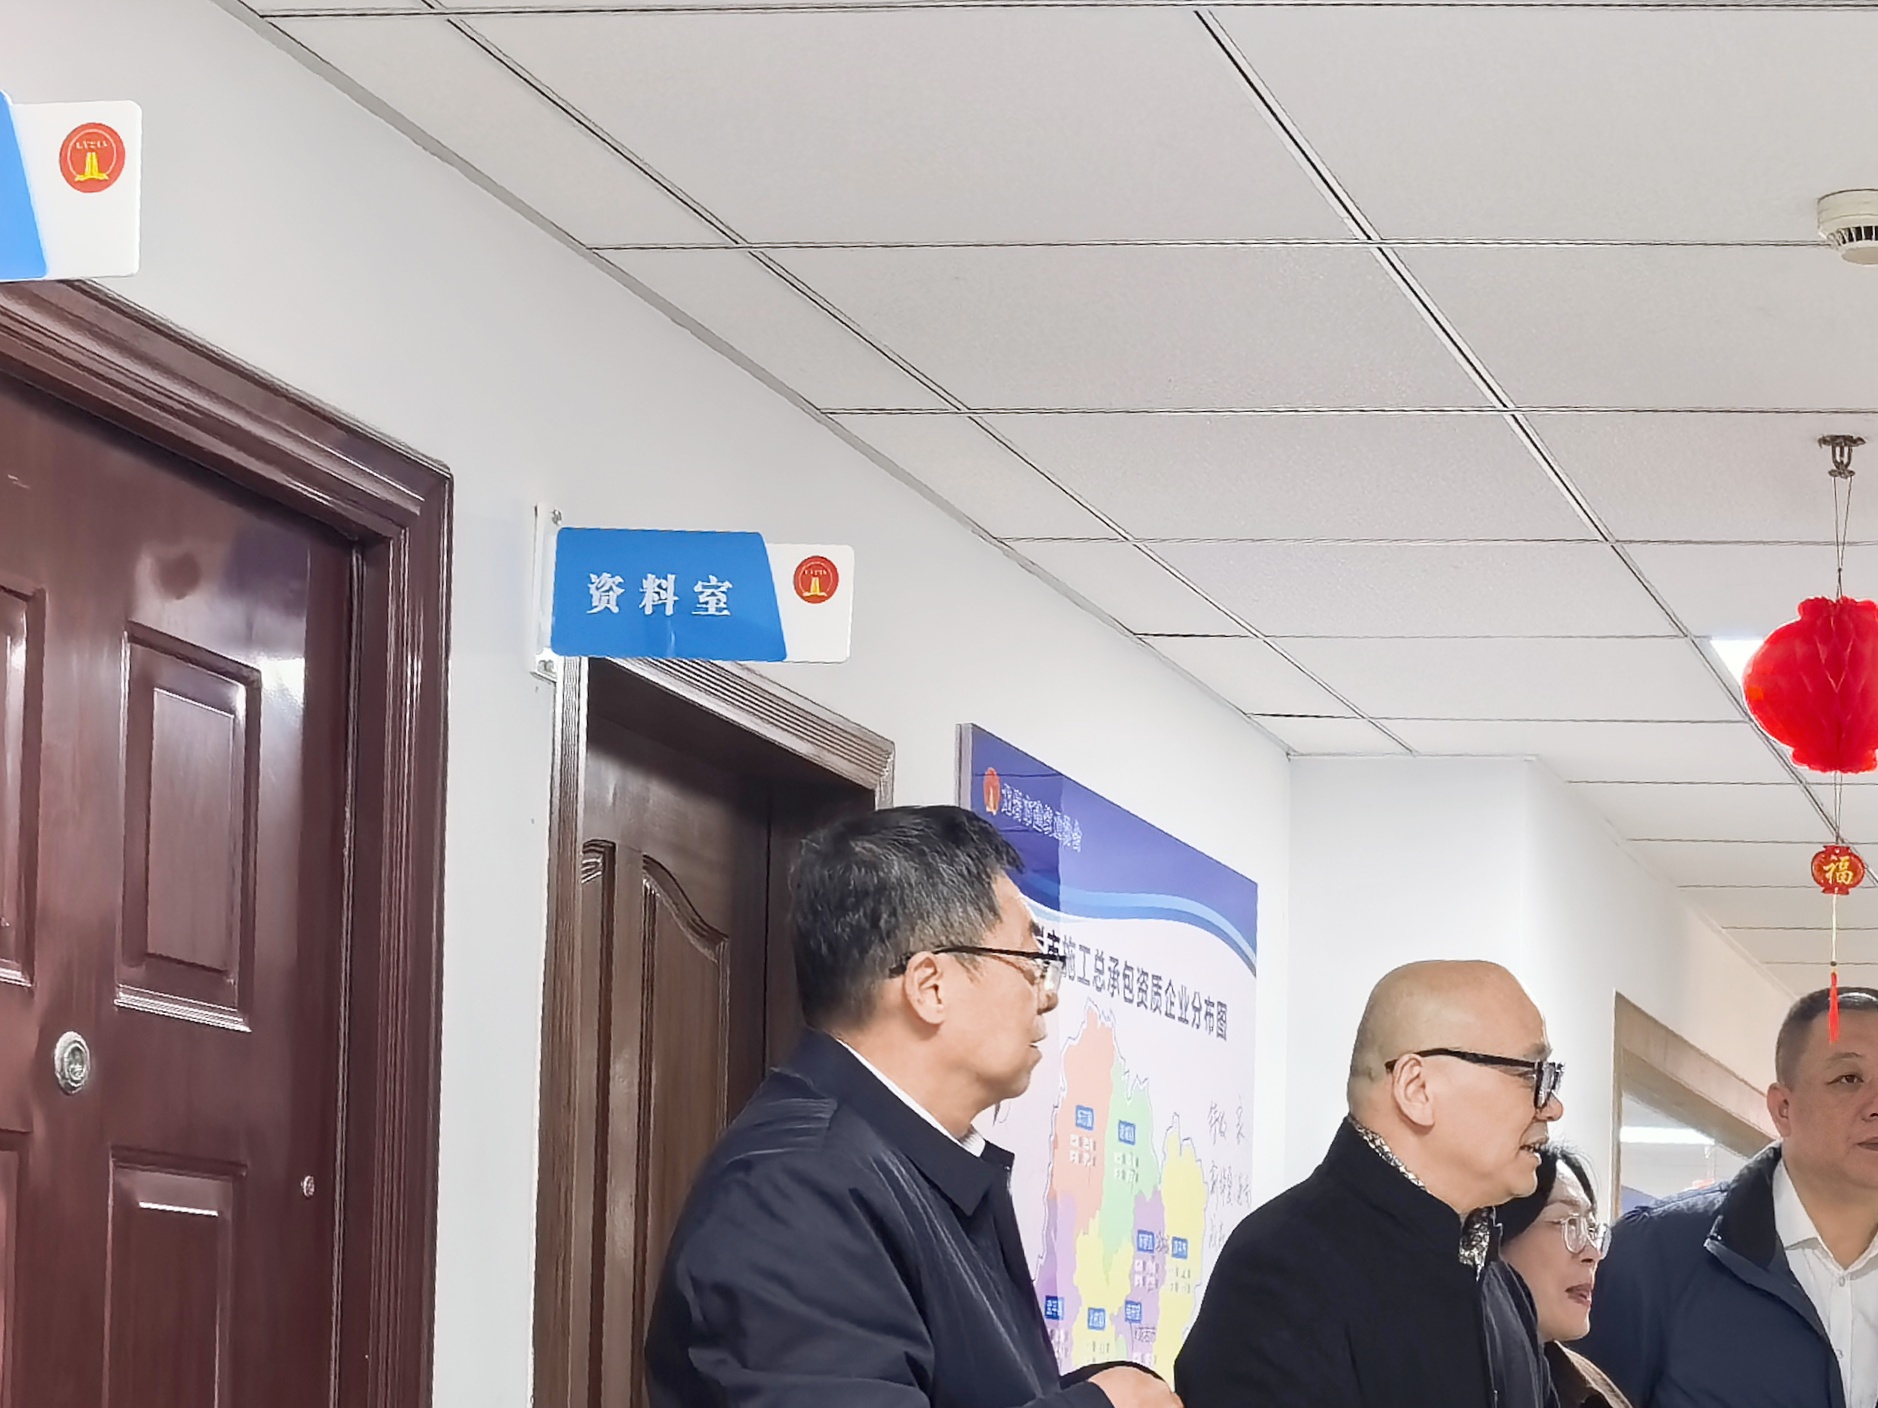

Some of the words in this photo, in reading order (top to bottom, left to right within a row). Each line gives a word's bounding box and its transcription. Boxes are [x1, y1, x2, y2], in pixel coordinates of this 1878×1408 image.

[586, 573, 733, 616] 资料室
[1822, 856, 1854, 886] 福
[1036, 926, 1228, 1041] 市施工总承包资质企业分布图
